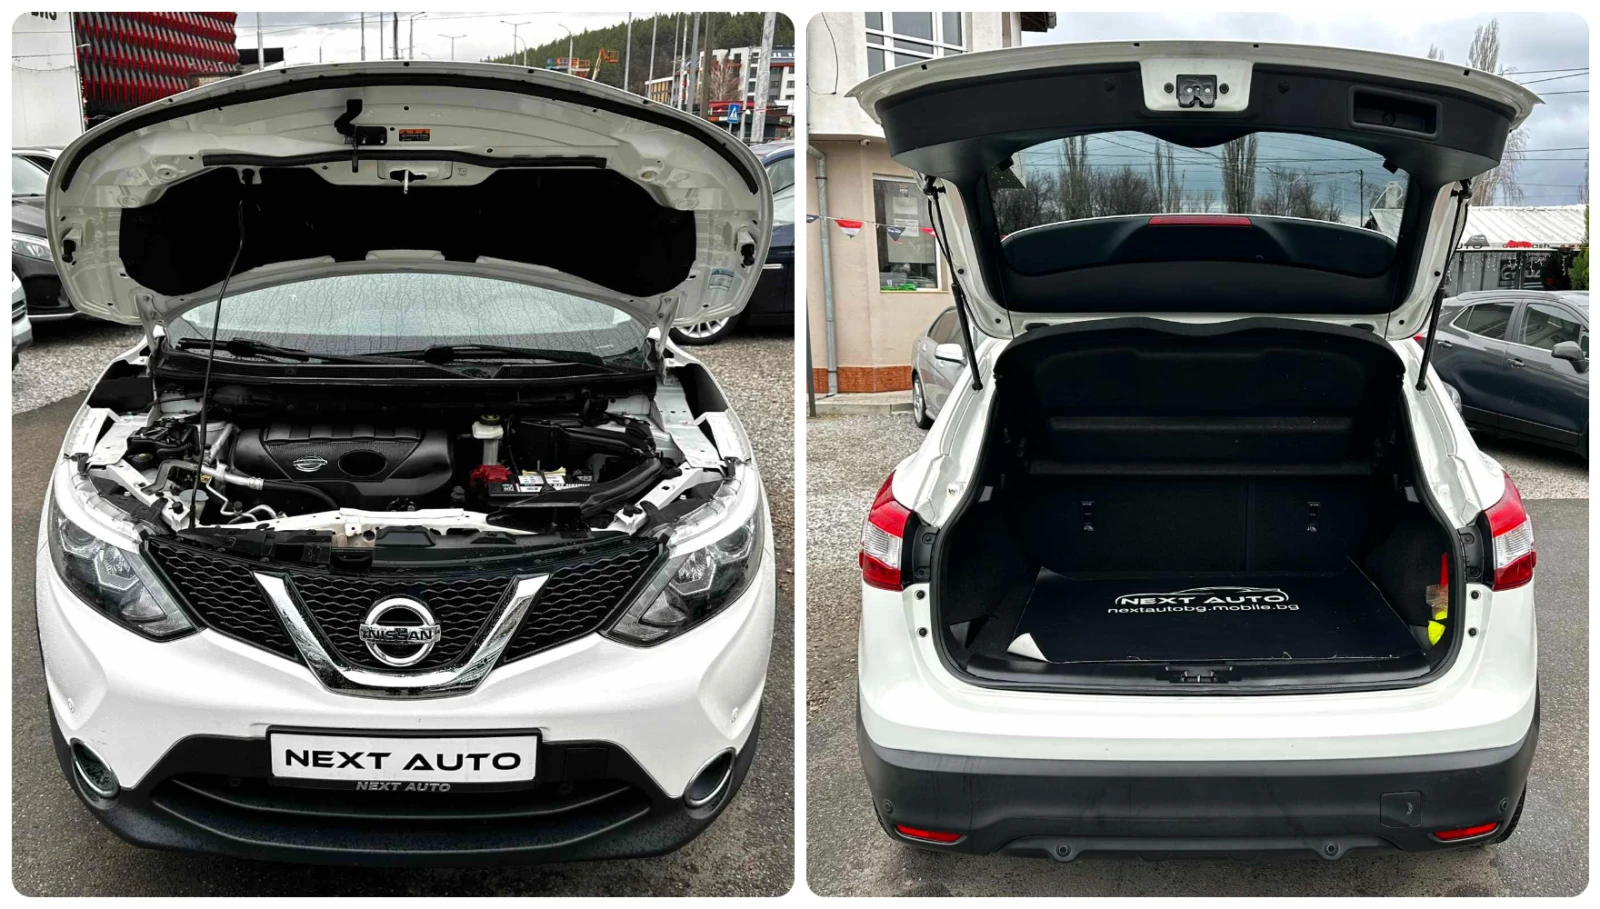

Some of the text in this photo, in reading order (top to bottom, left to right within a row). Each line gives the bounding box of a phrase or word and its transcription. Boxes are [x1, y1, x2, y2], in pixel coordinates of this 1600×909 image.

[1120, 596, 1284, 605] NEXT AUTO
[1107, 603, 1300, 614] nextautobg.mobile.bg
[367, 629, 432, 641] NISSAN
[285, 748, 521, 771] NEXT AUTO
[356, 781, 451, 793] NEXT AUTO
